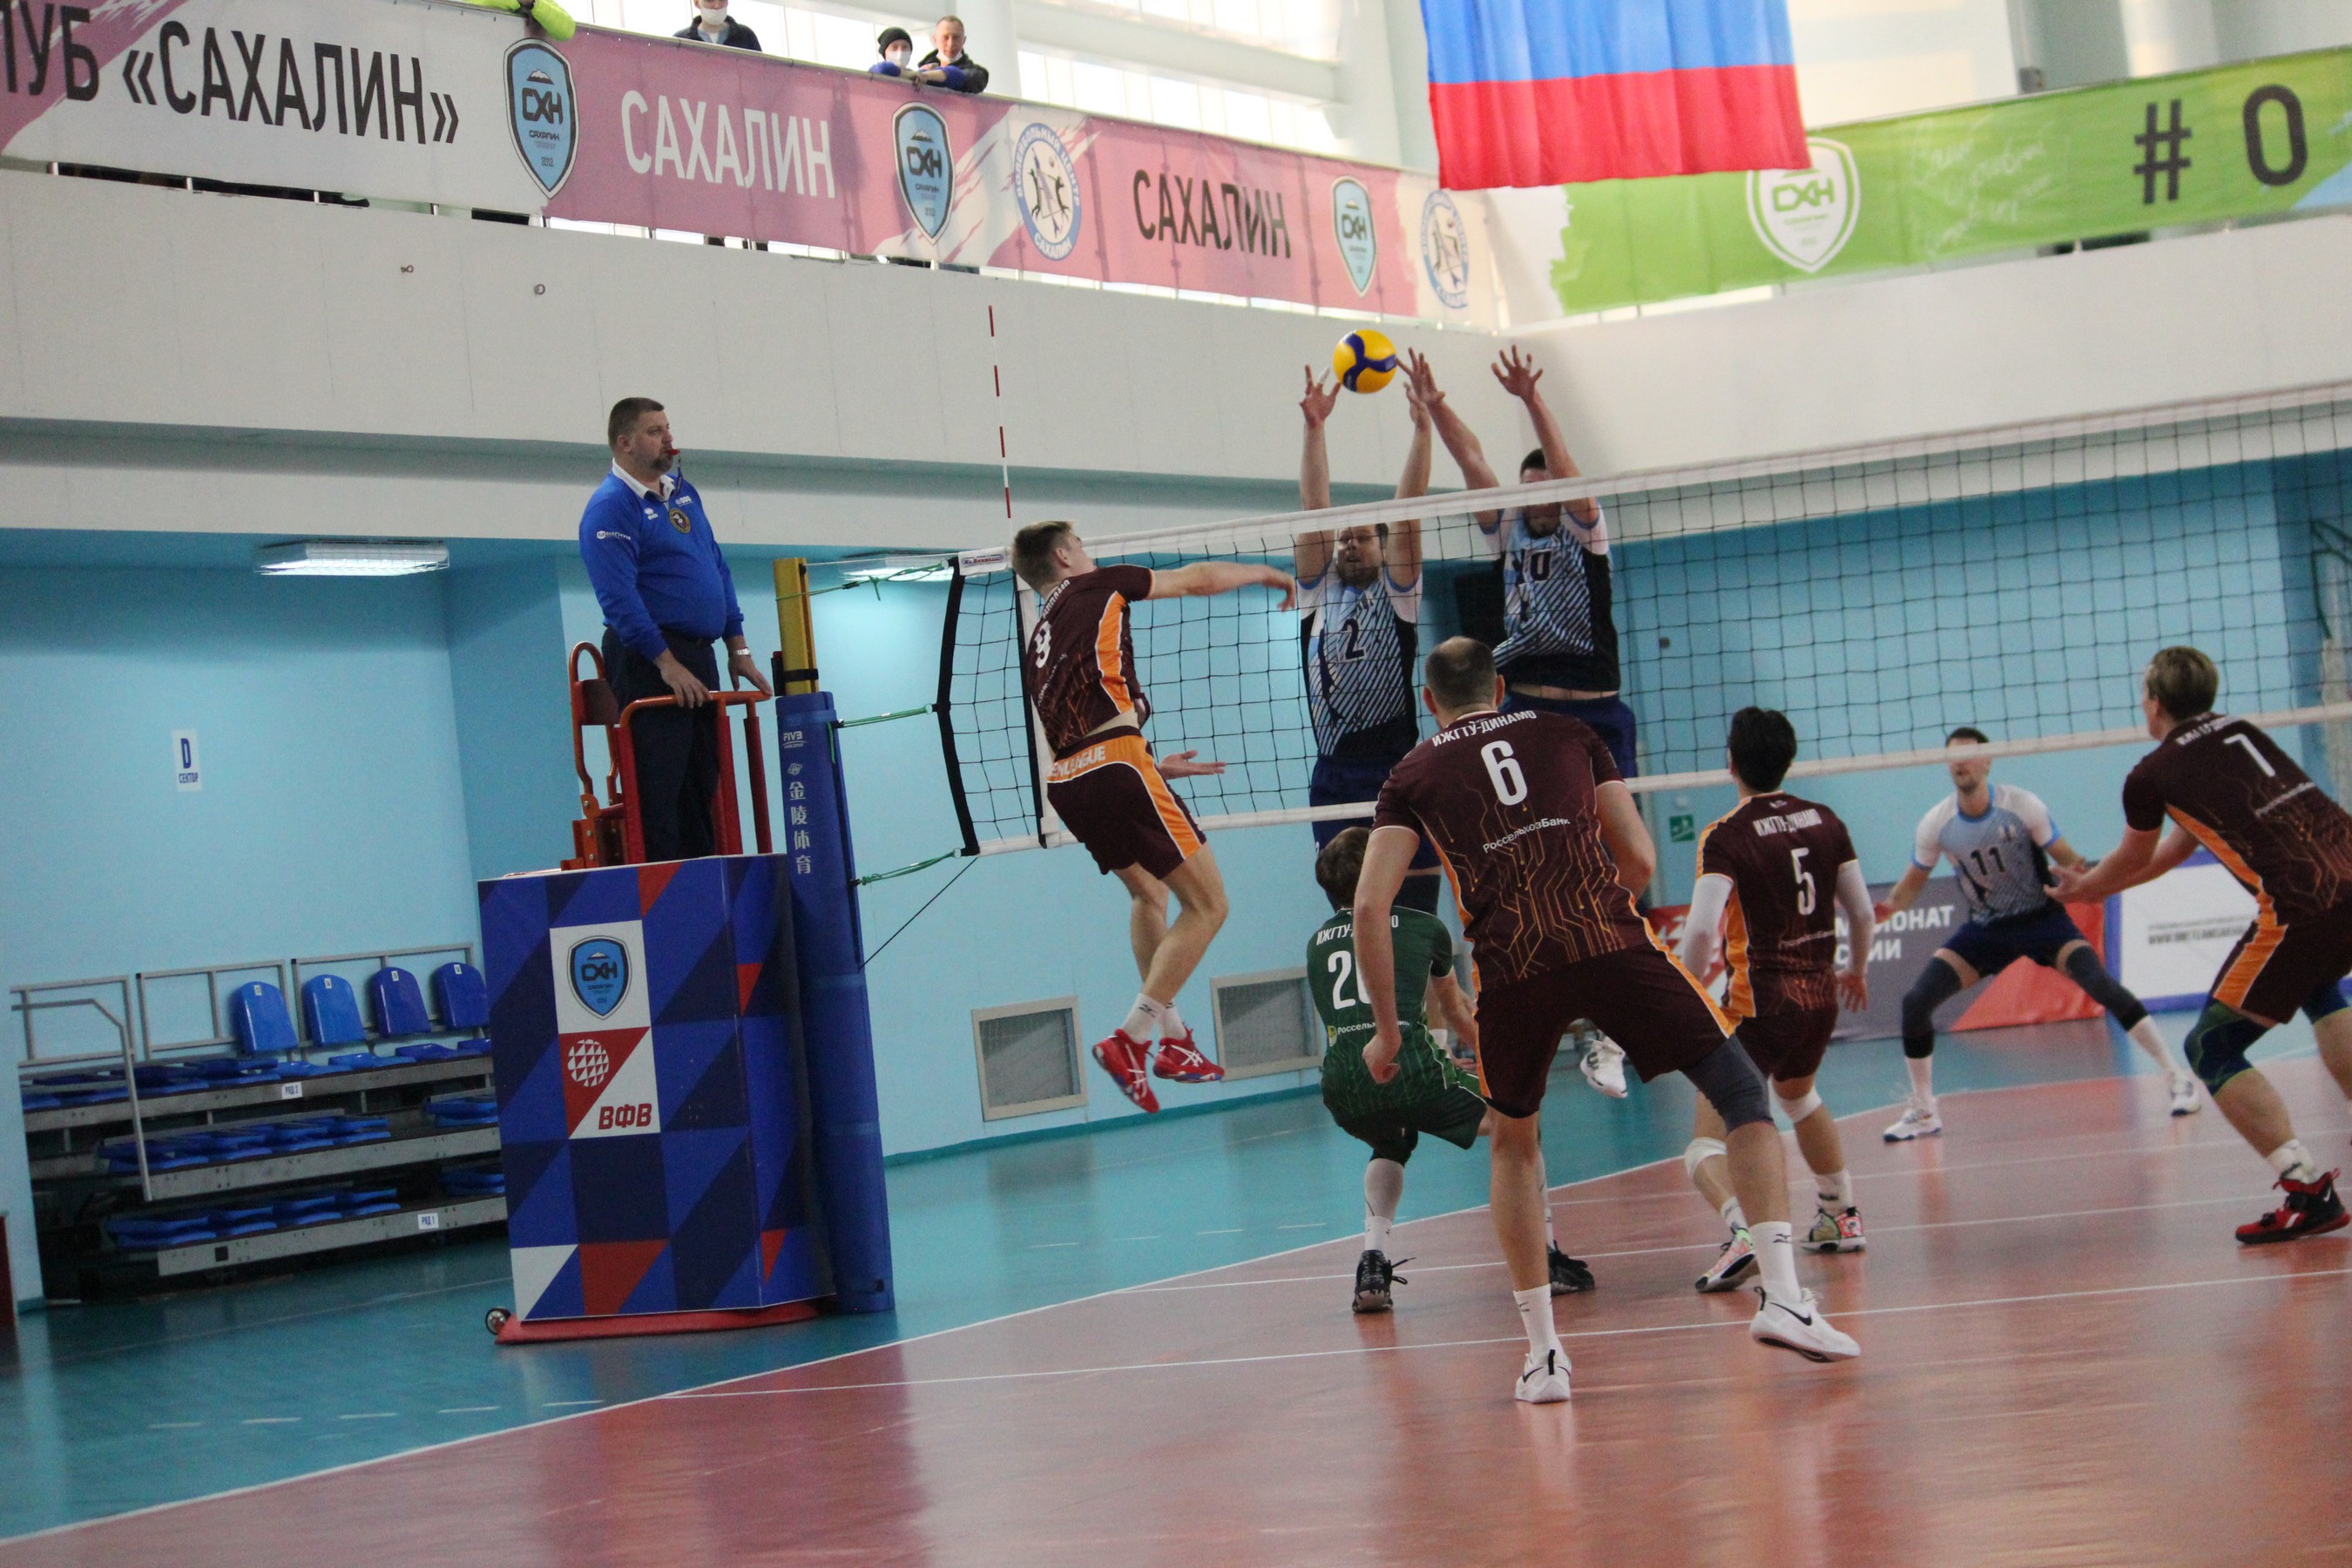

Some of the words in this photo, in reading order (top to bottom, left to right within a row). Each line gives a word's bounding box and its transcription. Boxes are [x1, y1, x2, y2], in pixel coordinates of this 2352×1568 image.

[122, 20, 460, 145] «САХАЛИН»
[621, 89, 837, 199] САХАЛИН
[1133, 169, 1292, 260] САХАЛИН
[1342, 618, 1366, 660] 2
[1431, 710, 1537, 747] ИЖГТУ-ДИНАМО
[180, 738, 192, 769] D
[1481, 740, 1528, 806] 6
[2223, 733, 2276, 777] 7
[789, 781, 812, 875] 金陵体育
[1790, 847, 1817, 916] 5
[1970, 846, 2006, 877] 11
[1316, 915, 1400, 947] ИЖГТУ-О
[598, 1103, 652, 1130] ВФВ
